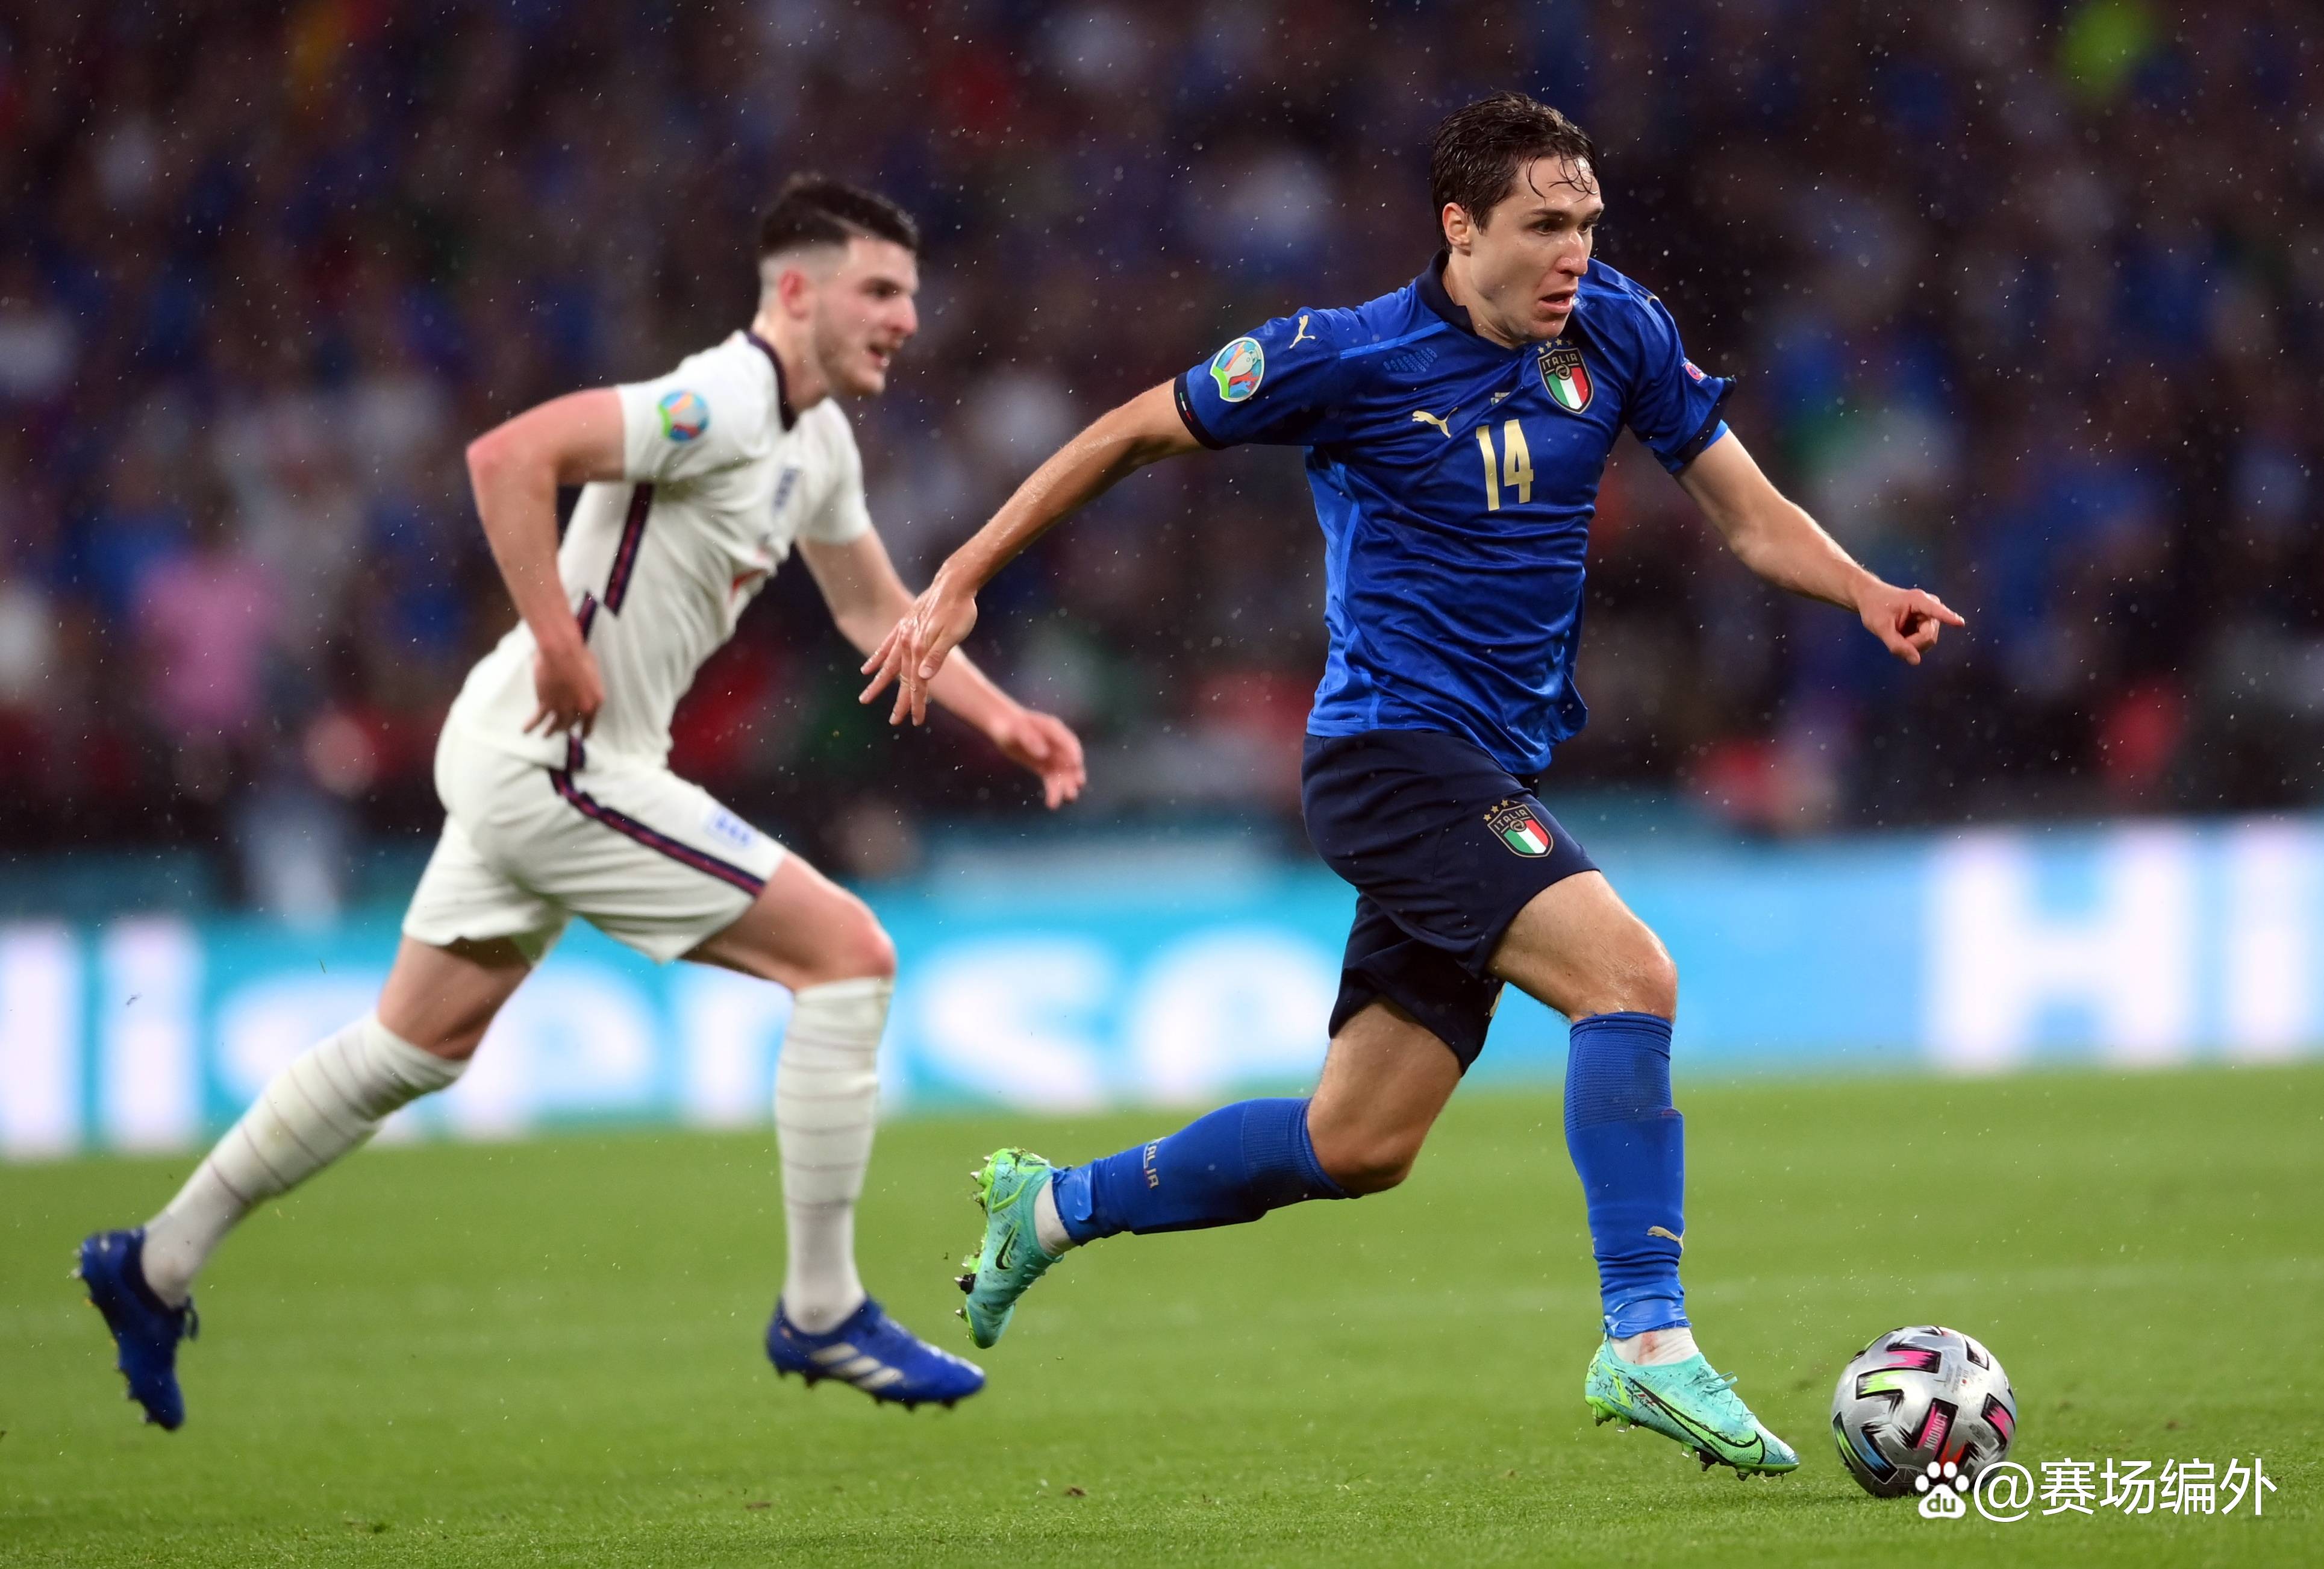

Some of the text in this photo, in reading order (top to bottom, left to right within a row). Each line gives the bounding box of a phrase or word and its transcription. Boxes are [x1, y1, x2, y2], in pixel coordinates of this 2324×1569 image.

[1542, 352, 1578, 370] ITALIA
[1476, 419, 1534, 511] 14
[1493, 809, 1528, 831] ITALIA
[1925, 1412, 1948, 1451] LONDON
